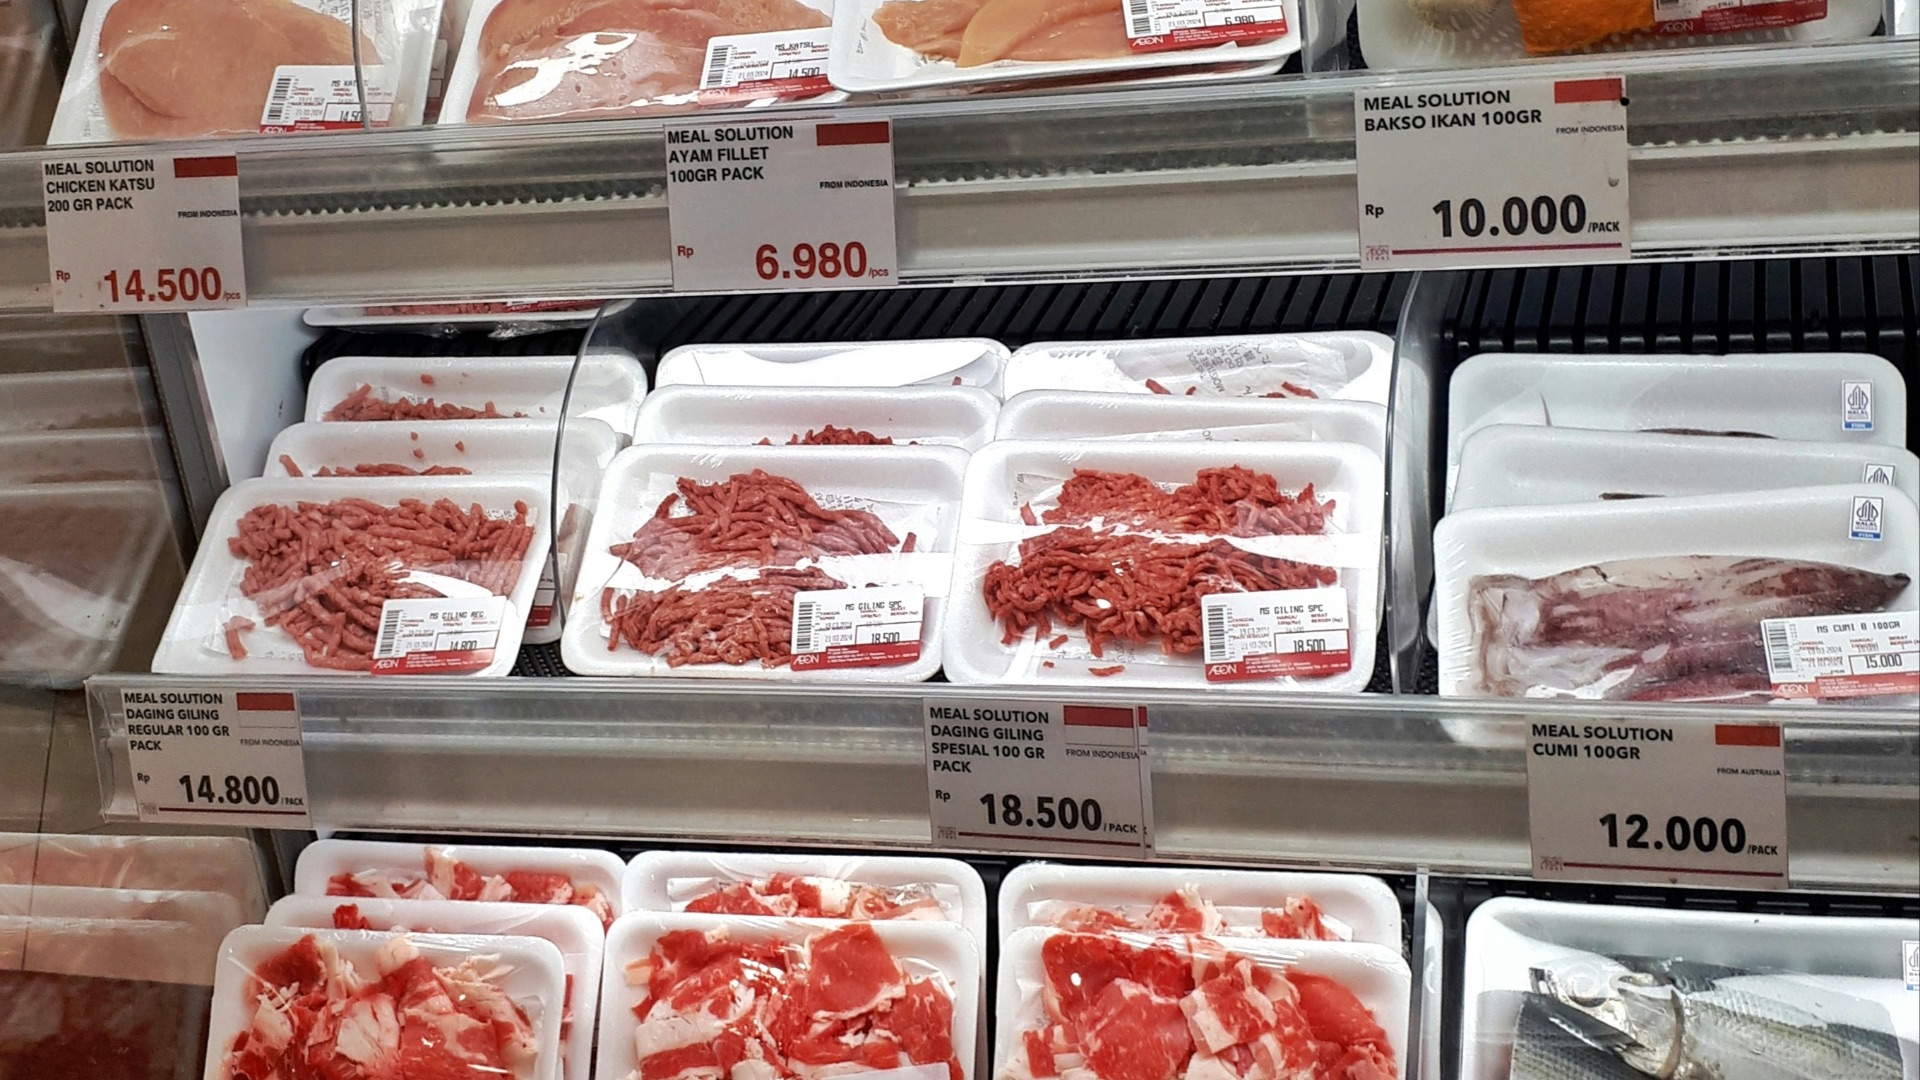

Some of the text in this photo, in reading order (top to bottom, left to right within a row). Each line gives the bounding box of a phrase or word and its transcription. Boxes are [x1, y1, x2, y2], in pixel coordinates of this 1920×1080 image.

[1224, 14, 1256, 27] 6980
[789, 66, 821, 79] 14500
[1364, 90, 1510, 111] MEAL SOLUTION
[1364, 109, 1542, 132] BAKSO IKAN 100GR
[668, 126, 794, 144] MEAL SOLUTION
[1556, 124, 1625, 135] FROM INDONESIA
[668, 146, 770, 164] AYAM FILLET
[45, 159, 155, 176] MEAL SOLUTION
[669, 166, 765, 183] 100GR PACK
[46, 177, 156, 194] CHICKEN KATSU
[819, 179, 889, 189] FROM INDONESIA
[48, 197, 134, 212] 200 GR PACK
[177, 209, 238, 219] FROM INDONESIA
[1365, 194, 1620, 238] Rp 10.000 /PACK
[677, 241, 889, 280] Rp 6.980 /pcs
[56, 266, 241, 303] Rp 14.500 /pcs
[858, 601, 886, 610] GILING
[1274, 604, 1304, 615] GILING
[1307, 603, 1324, 613] SPC
[441, 611, 468, 620] GILING
[1832, 622, 1855, 633] CUMI
[449, 640, 478, 651] 14800
[871, 631, 901, 645] 18500
[1293, 638, 1326, 653] 18500
[1865, 653, 1903, 669] 15.000
[124, 693, 223, 704] MEAL SOLUTION
[126, 708, 220, 721] DAGING GILING
[929, 706, 1049, 724] MEAL SOLUTION
[128, 724, 230, 737] REGULAR 100 GR
[931, 724, 1044, 742] DAGING GILING
[1532, 723, 1674, 742] MEAL SOLUTION
[130, 740, 163, 751] PACK
[931, 742, 1046, 760] SPESIAL 100 GR
[1532, 742, 1641, 760] CUMI 100GR
[1065, 748, 1091, 758] FROM
[1092, 749, 1139, 760] INDONESIA
[932, 759, 972, 773] PACK
[1716, 767, 1781, 776] FROM AUSTRALIA
[137, 772, 151, 784] Rp
[178, 774, 280, 806] 14.800
[935, 789, 951, 803] Rp
[980, 793, 1102, 832] 18.500
[1599, 813, 1778, 856] 12.000 /PACK
